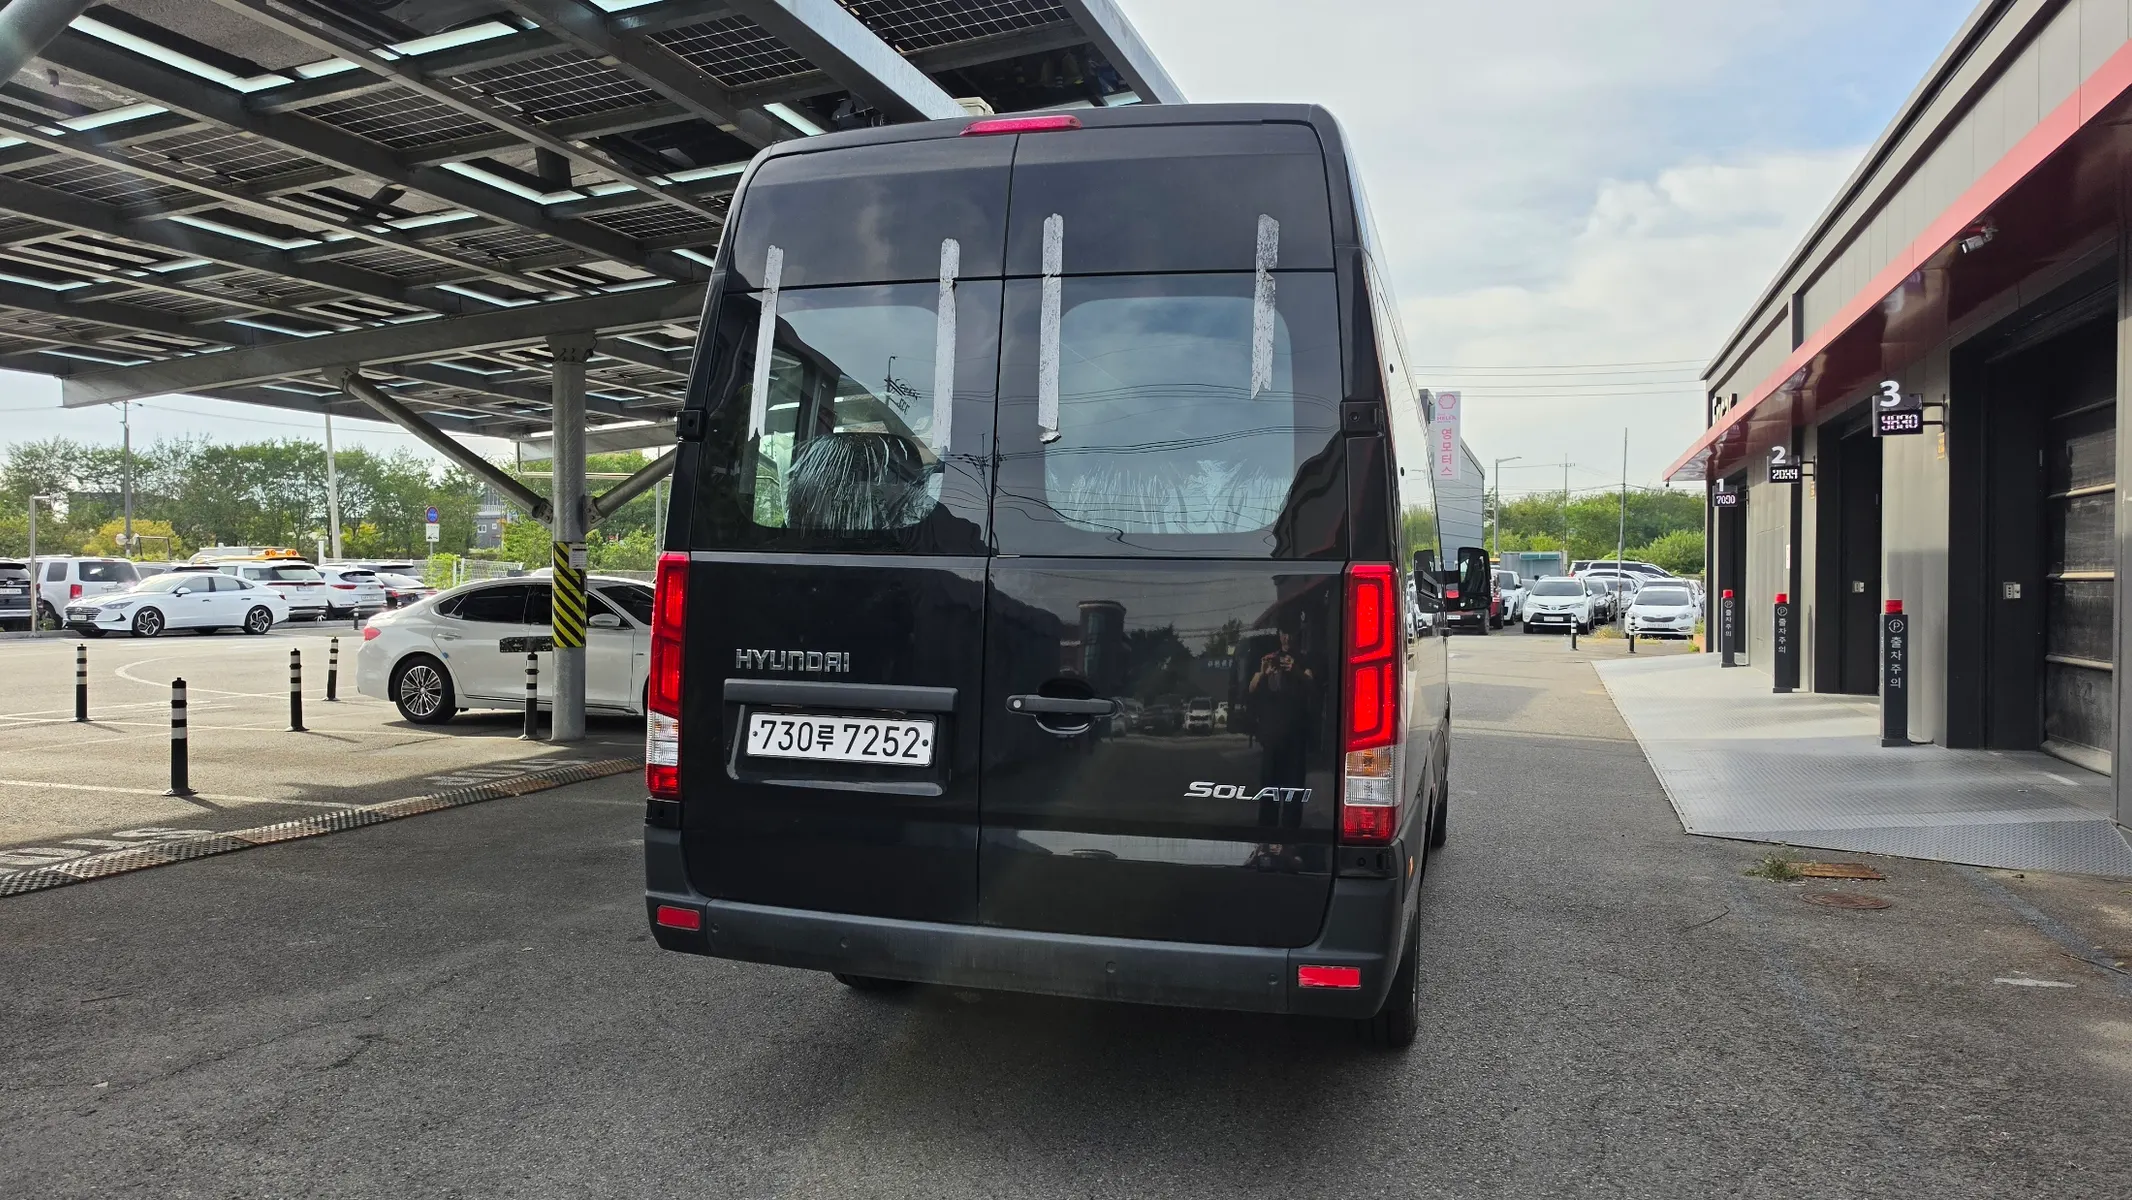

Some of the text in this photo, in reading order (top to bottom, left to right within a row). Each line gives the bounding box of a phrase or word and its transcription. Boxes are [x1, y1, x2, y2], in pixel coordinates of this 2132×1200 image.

[1879, 380, 1902, 408] 3
[1440, 428, 1453, 476] 영모터스
[1771, 445, 1786, 464] 2
[1716, 478, 1725, 492] 1
[735, 648, 850, 673] HYUNDAI
[1889, 636, 1903, 689] 출차주의
[760, 719, 920, 759] 730루 7252
[1183, 781, 1313, 803] SOLATI
